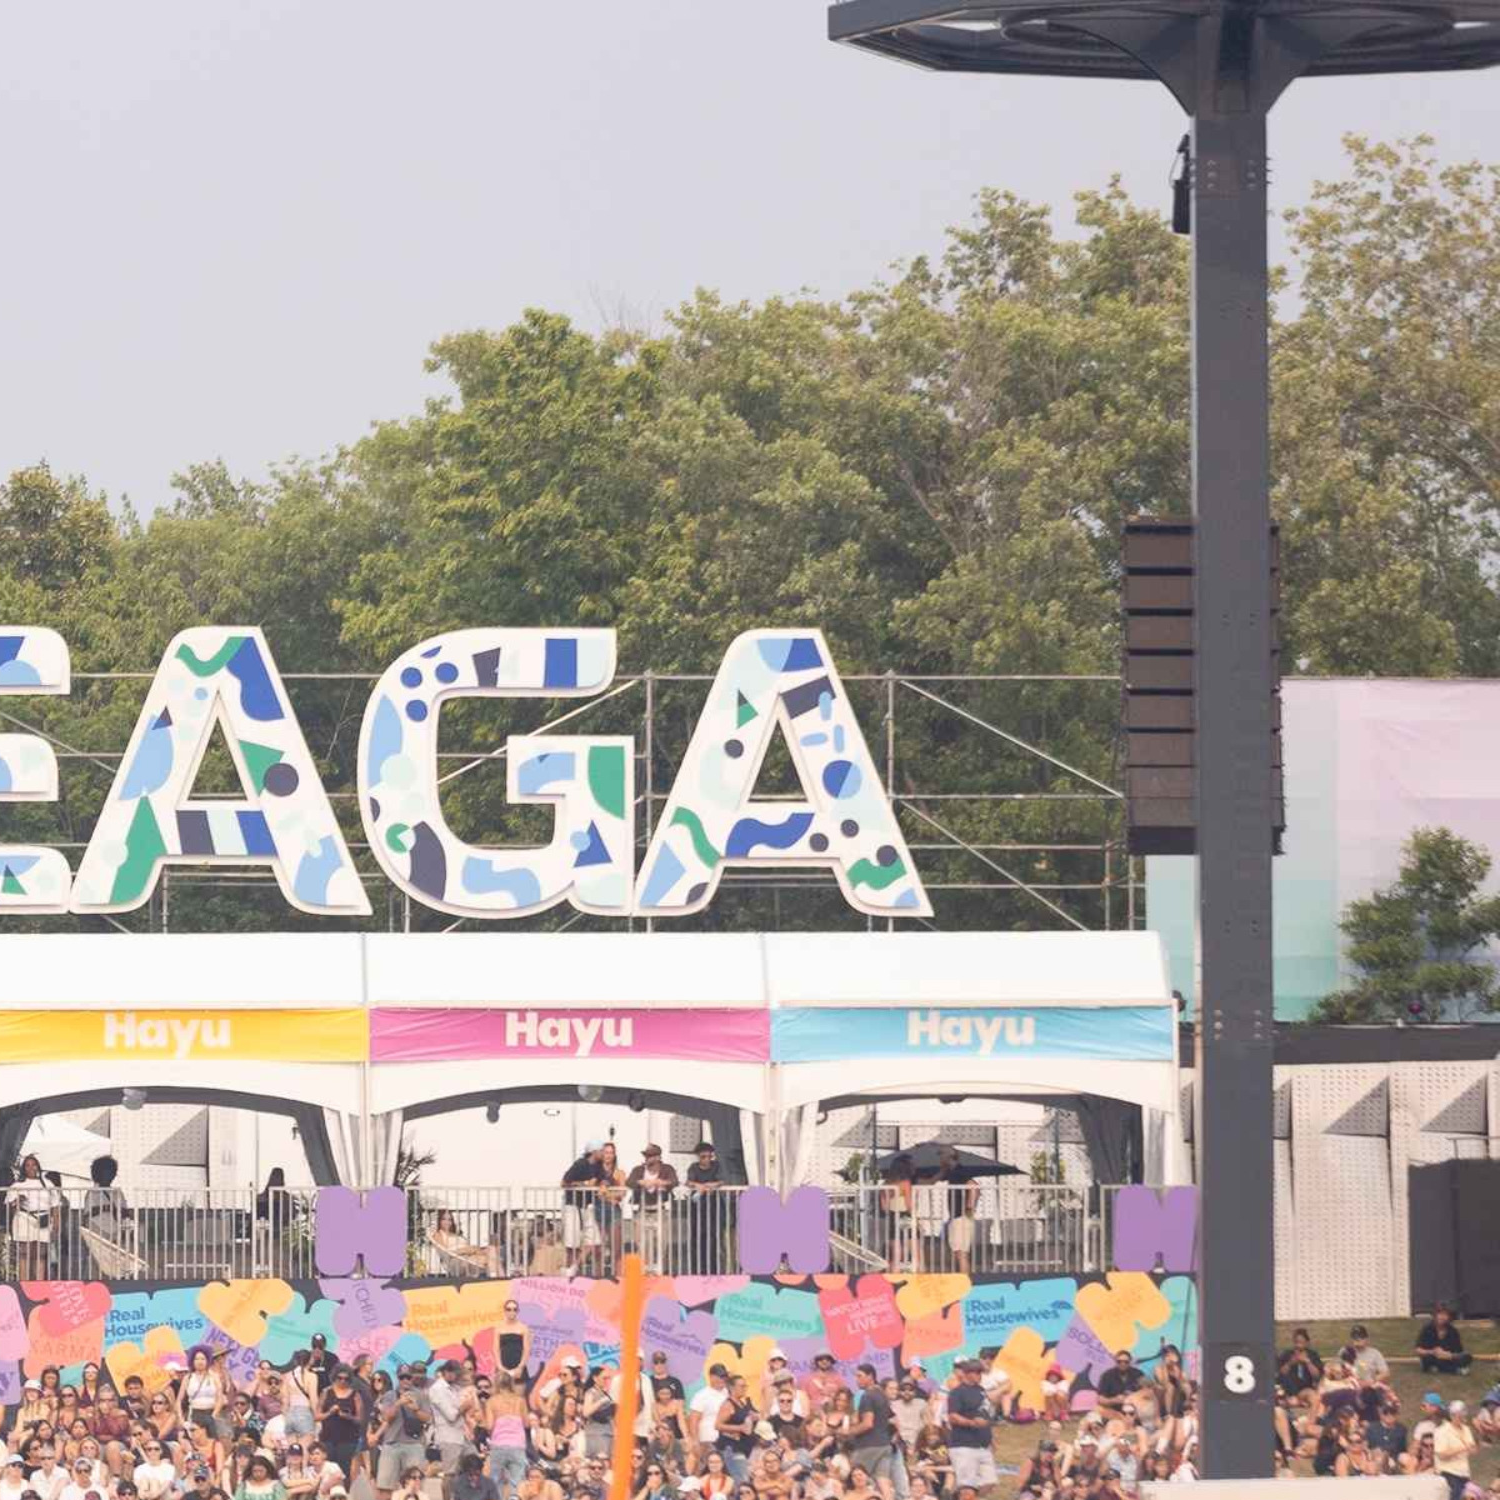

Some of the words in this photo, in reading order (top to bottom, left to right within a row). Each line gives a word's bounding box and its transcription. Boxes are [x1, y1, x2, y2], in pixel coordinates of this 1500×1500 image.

[104, 1012, 231, 1057] Hayu
[505, 1011, 634, 1057] Hayu
[907, 1009, 1036, 1056] Hayu
[110, 1306, 145, 1322] Real
[966, 1308, 1060, 1326] Housewives
[971, 1296, 1005, 1312] Real
[105, 1317, 203, 1337] Houseives
[1224, 1355, 1256, 1393] 8
